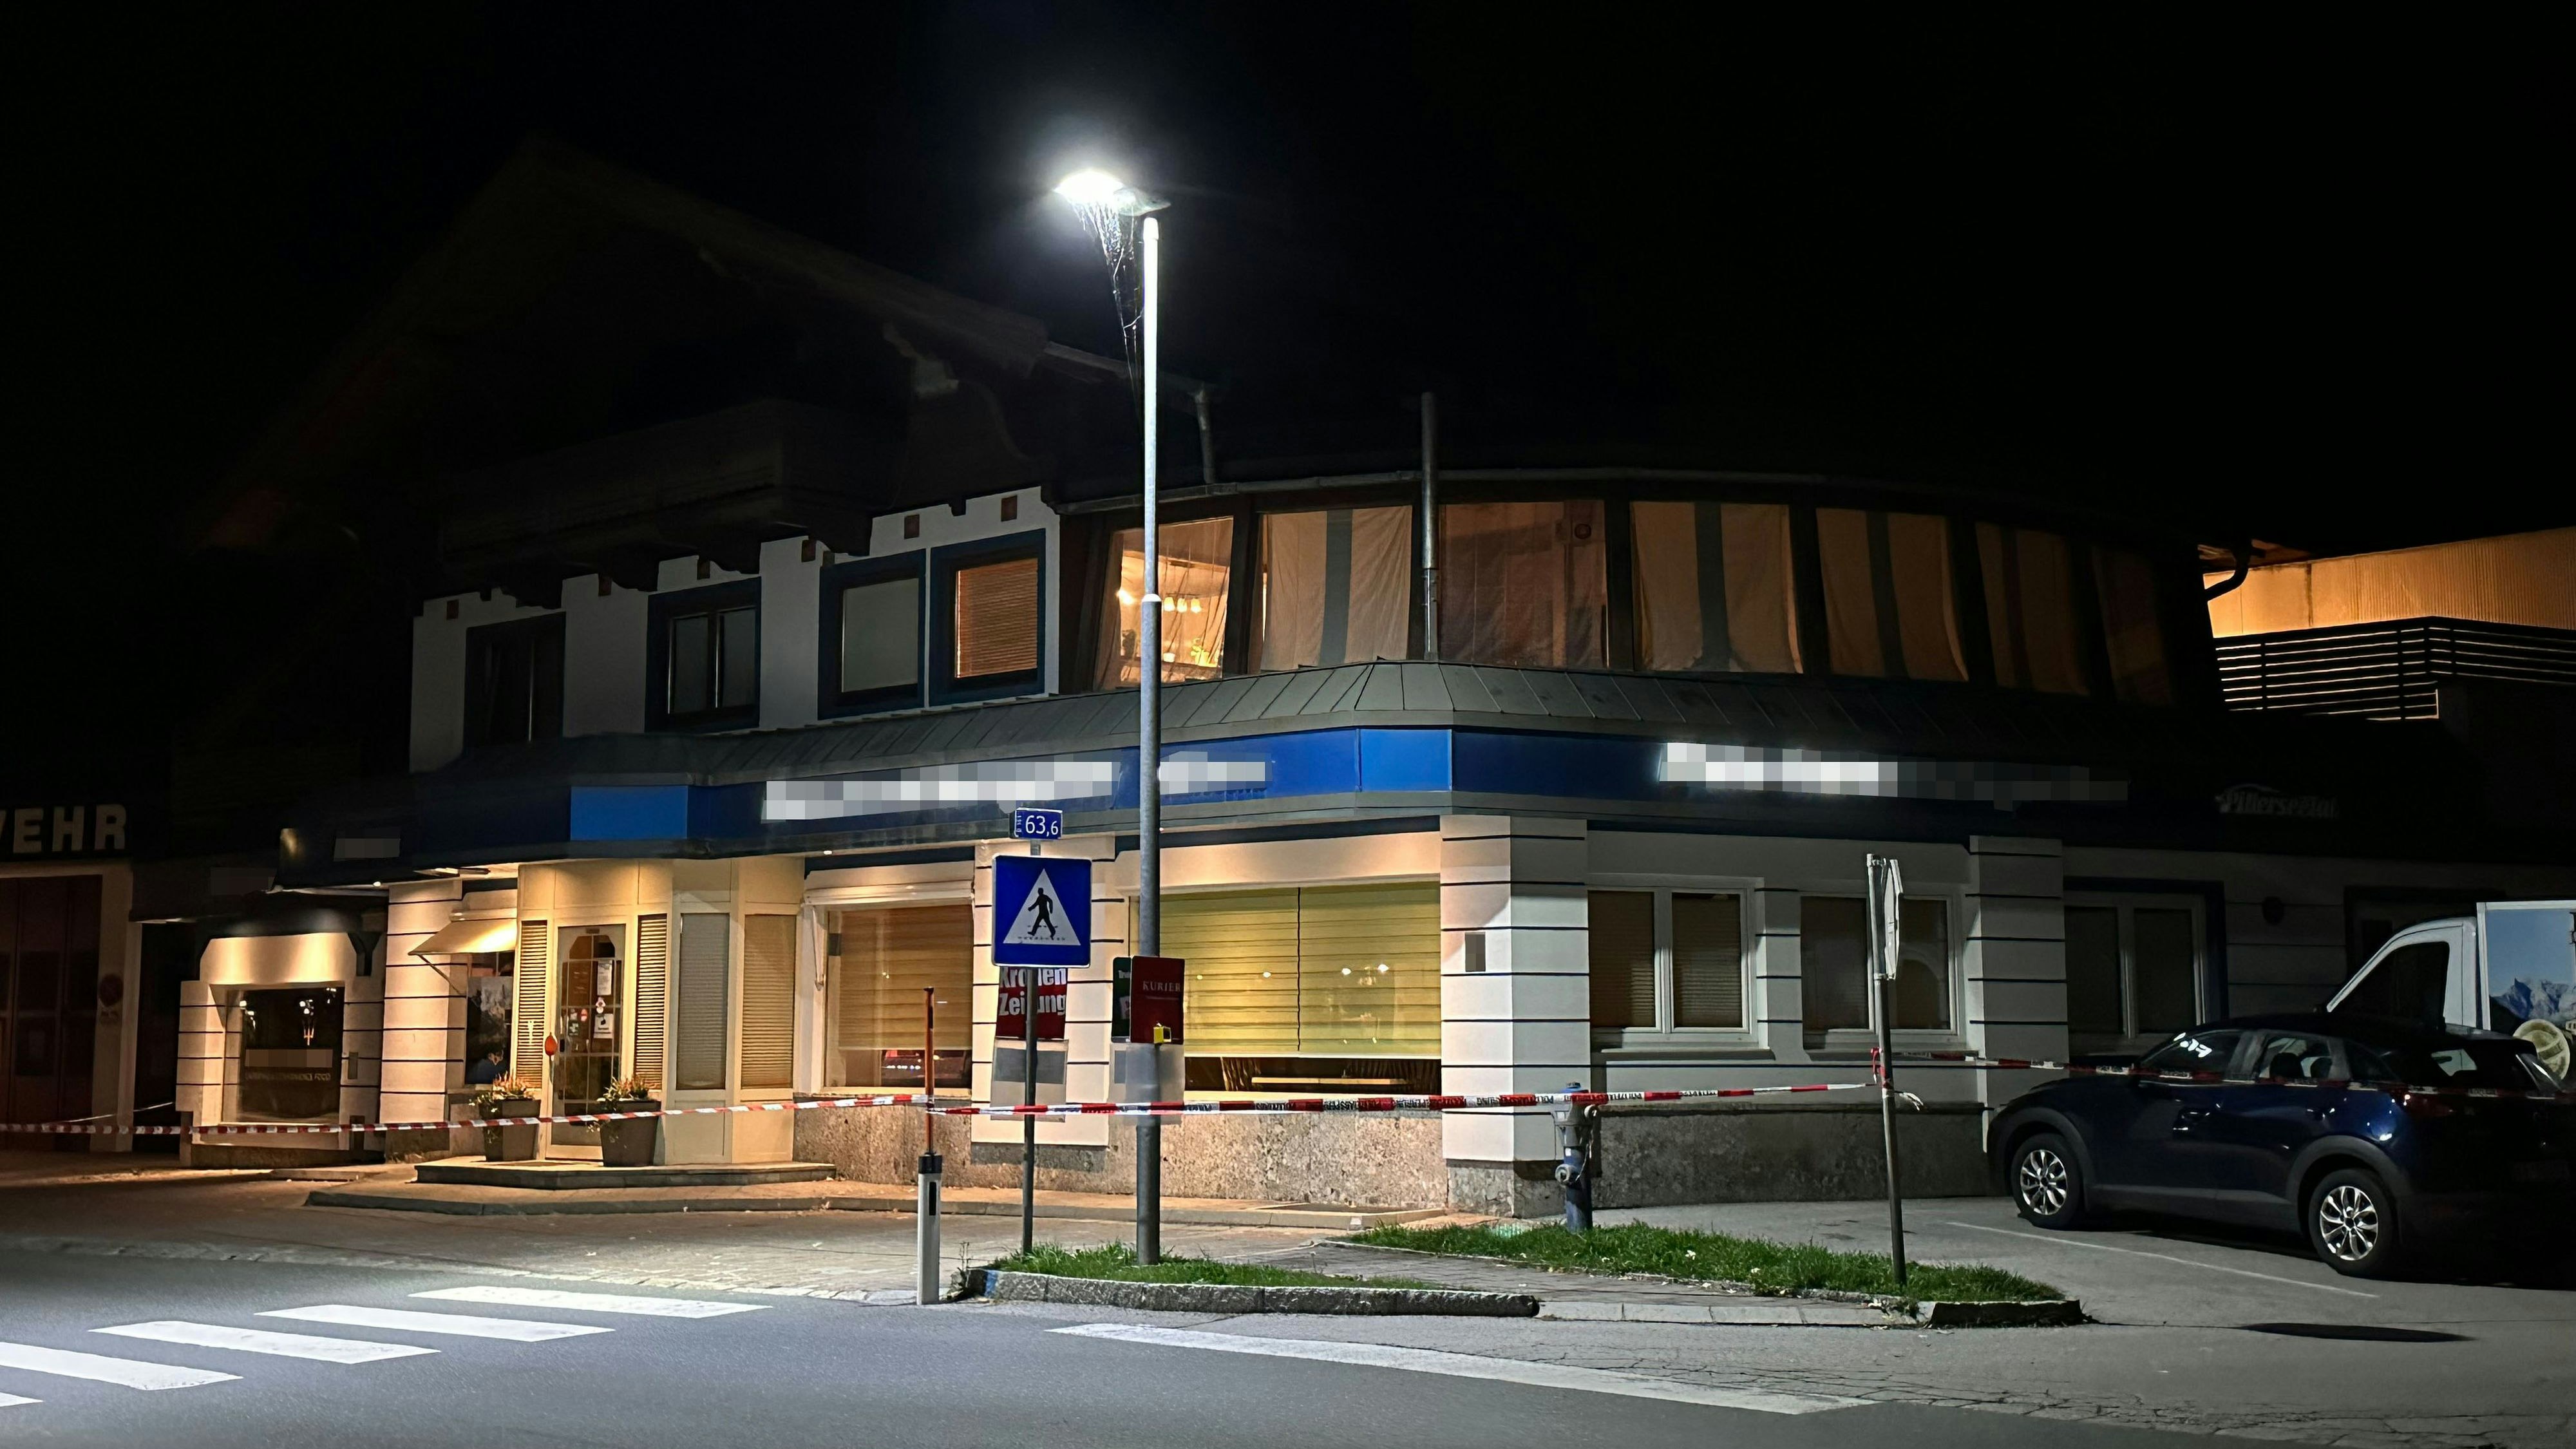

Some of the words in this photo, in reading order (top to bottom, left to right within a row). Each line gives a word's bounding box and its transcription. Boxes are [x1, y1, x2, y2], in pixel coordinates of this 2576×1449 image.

[0, 804, 127, 854] EHR
[1025, 815, 1059, 837] 63,6
[1142, 980, 1181, 992] KURIER
[998, 990, 1066, 1016] Zeiung
